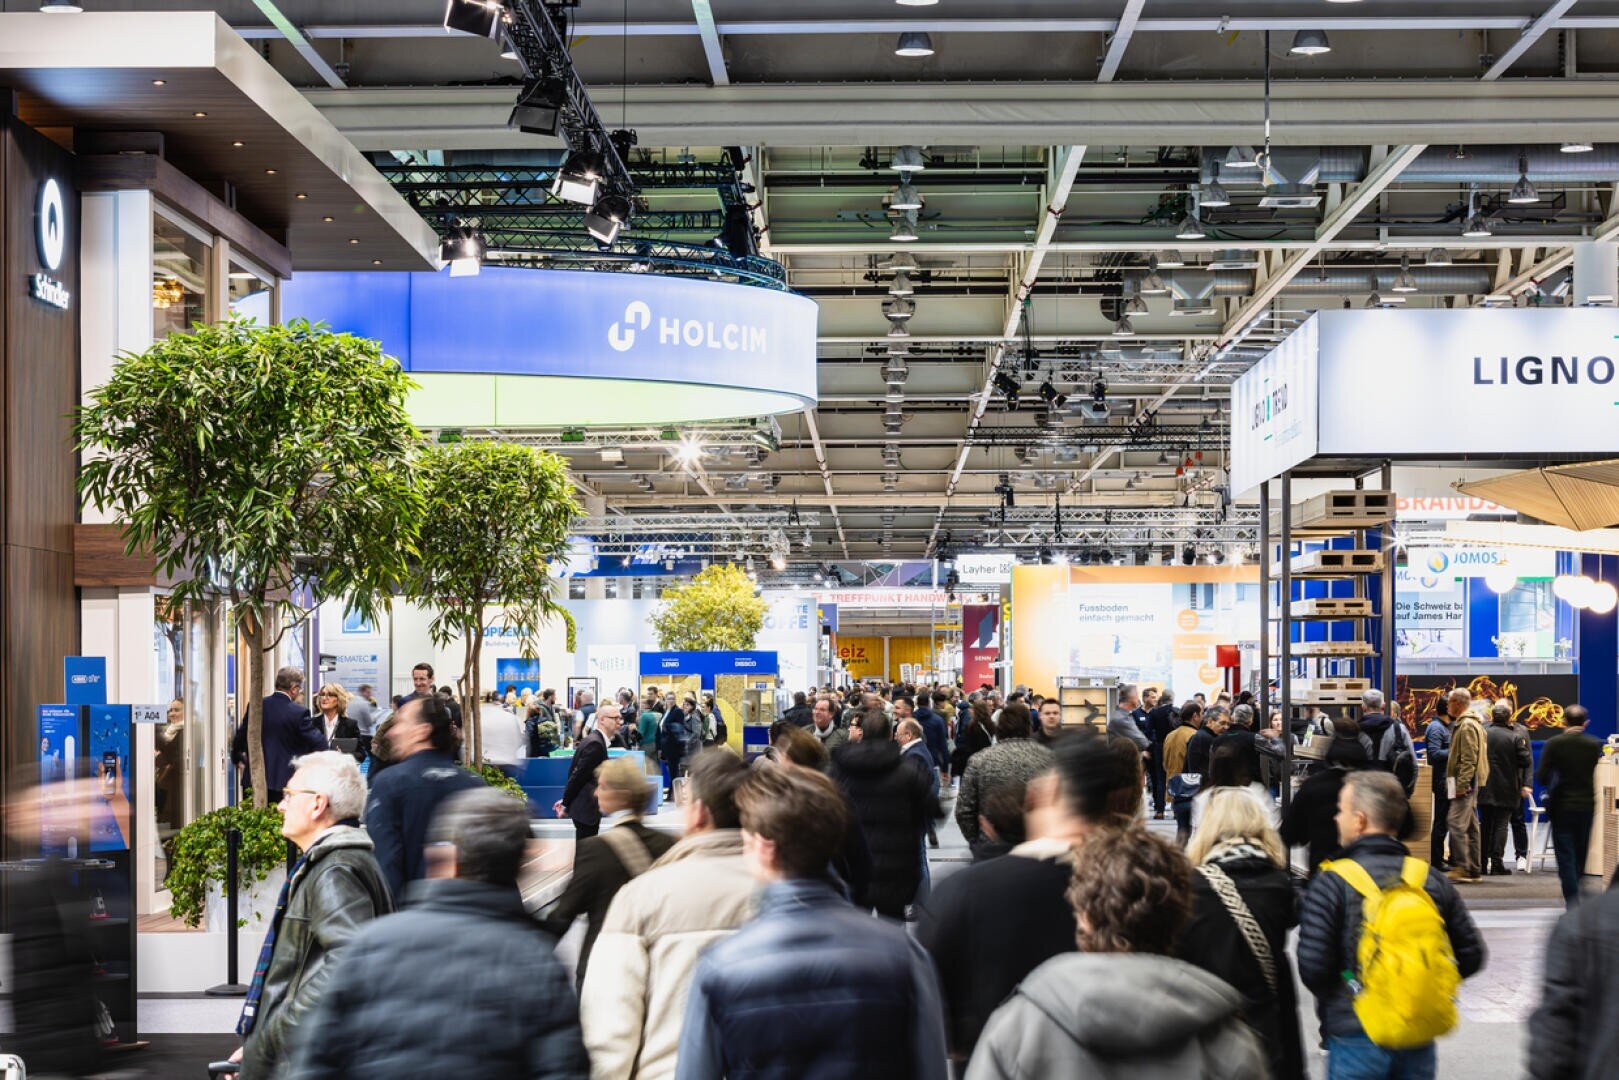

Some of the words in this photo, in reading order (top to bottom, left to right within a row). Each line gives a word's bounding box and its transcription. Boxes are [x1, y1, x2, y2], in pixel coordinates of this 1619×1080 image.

[659, 317, 767, 354] HOLCIM
[1474, 356, 1615, 385] LIGNO
[1396, 496, 1514, 511] BRANDS
[1453, 551, 1499, 564] JOMOS
[963, 563, 996, 575] Layher
[1079, 603, 1129, 612] Fussboden
[1396, 602, 1411, 610] Die
[1413, 601, 1452, 611] Schweiz
[1079, 613, 1112, 621] einfach
[1114, 613, 1154, 624] gemacht
[1396, 612, 1411, 620] auf
[1412, 611, 1444, 620] James
